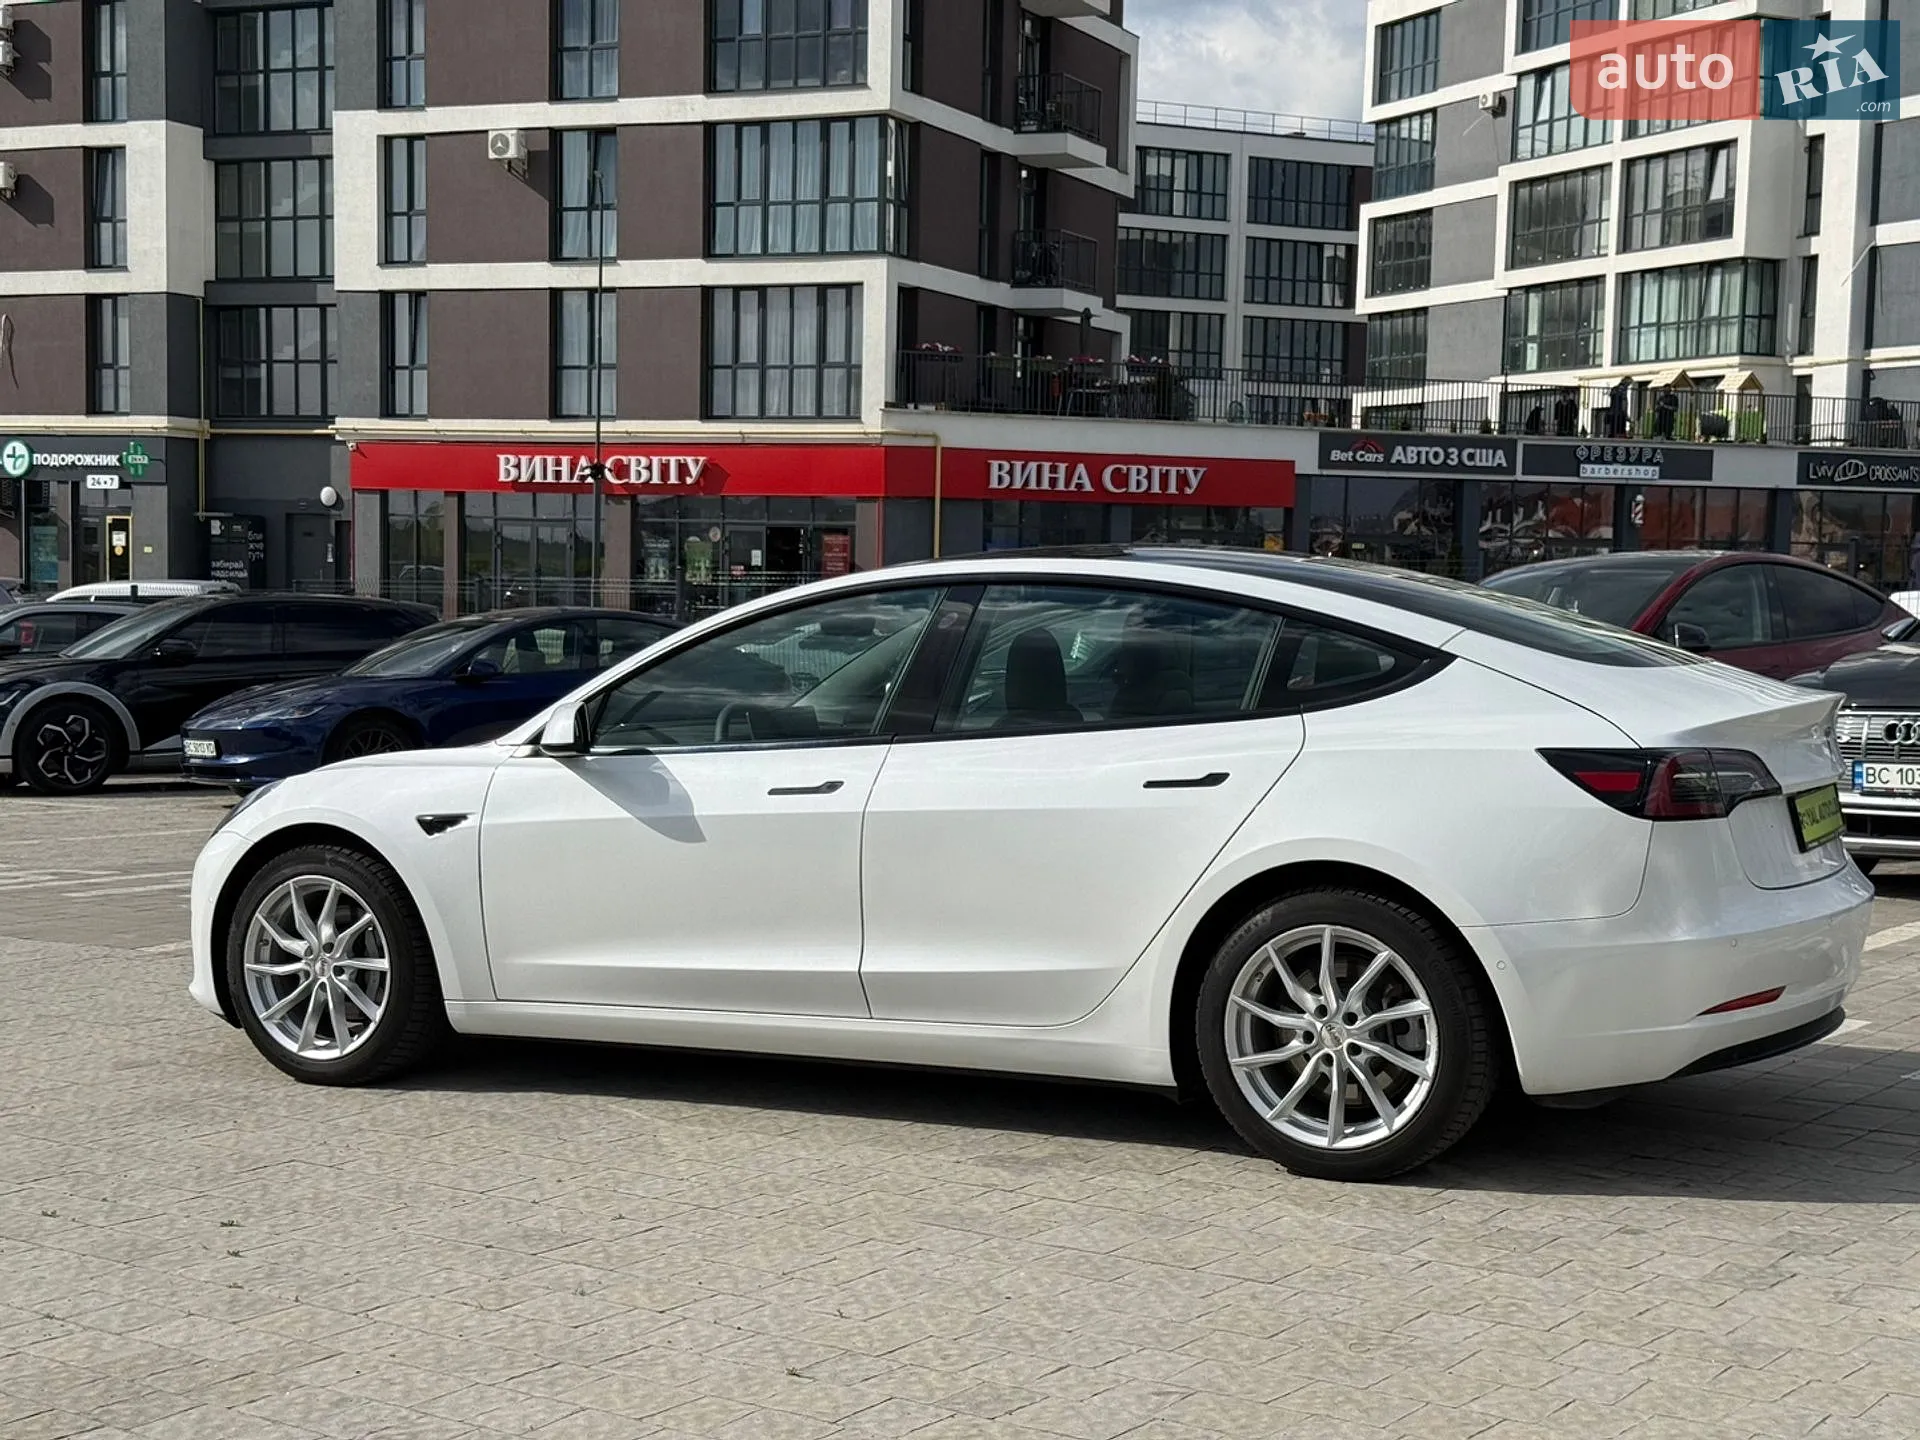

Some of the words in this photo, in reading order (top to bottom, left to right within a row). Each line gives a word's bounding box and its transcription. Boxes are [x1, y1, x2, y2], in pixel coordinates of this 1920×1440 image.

[33, 453, 121, 467] ПОДОРОЖНИК
[1330, 449, 1353, 462] Bet
[1355, 450, 1385, 463] Cars
[1389, 446, 1445, 465] АВТО
[1461, 448, 1508, 468] США
[1575, 445, 1664, 463] ФРЕЗУРА
[497, 454, 597, 483] ВИНА
[604, 455, 707, 485] СВІТУ
[987, 459, 1095, 492] ВИНА
[1101, 464, 1208, 495] СВІТУ
[1581, 466, 1658, 477] barbershop
[1865, 767, 1890, 784] BC
